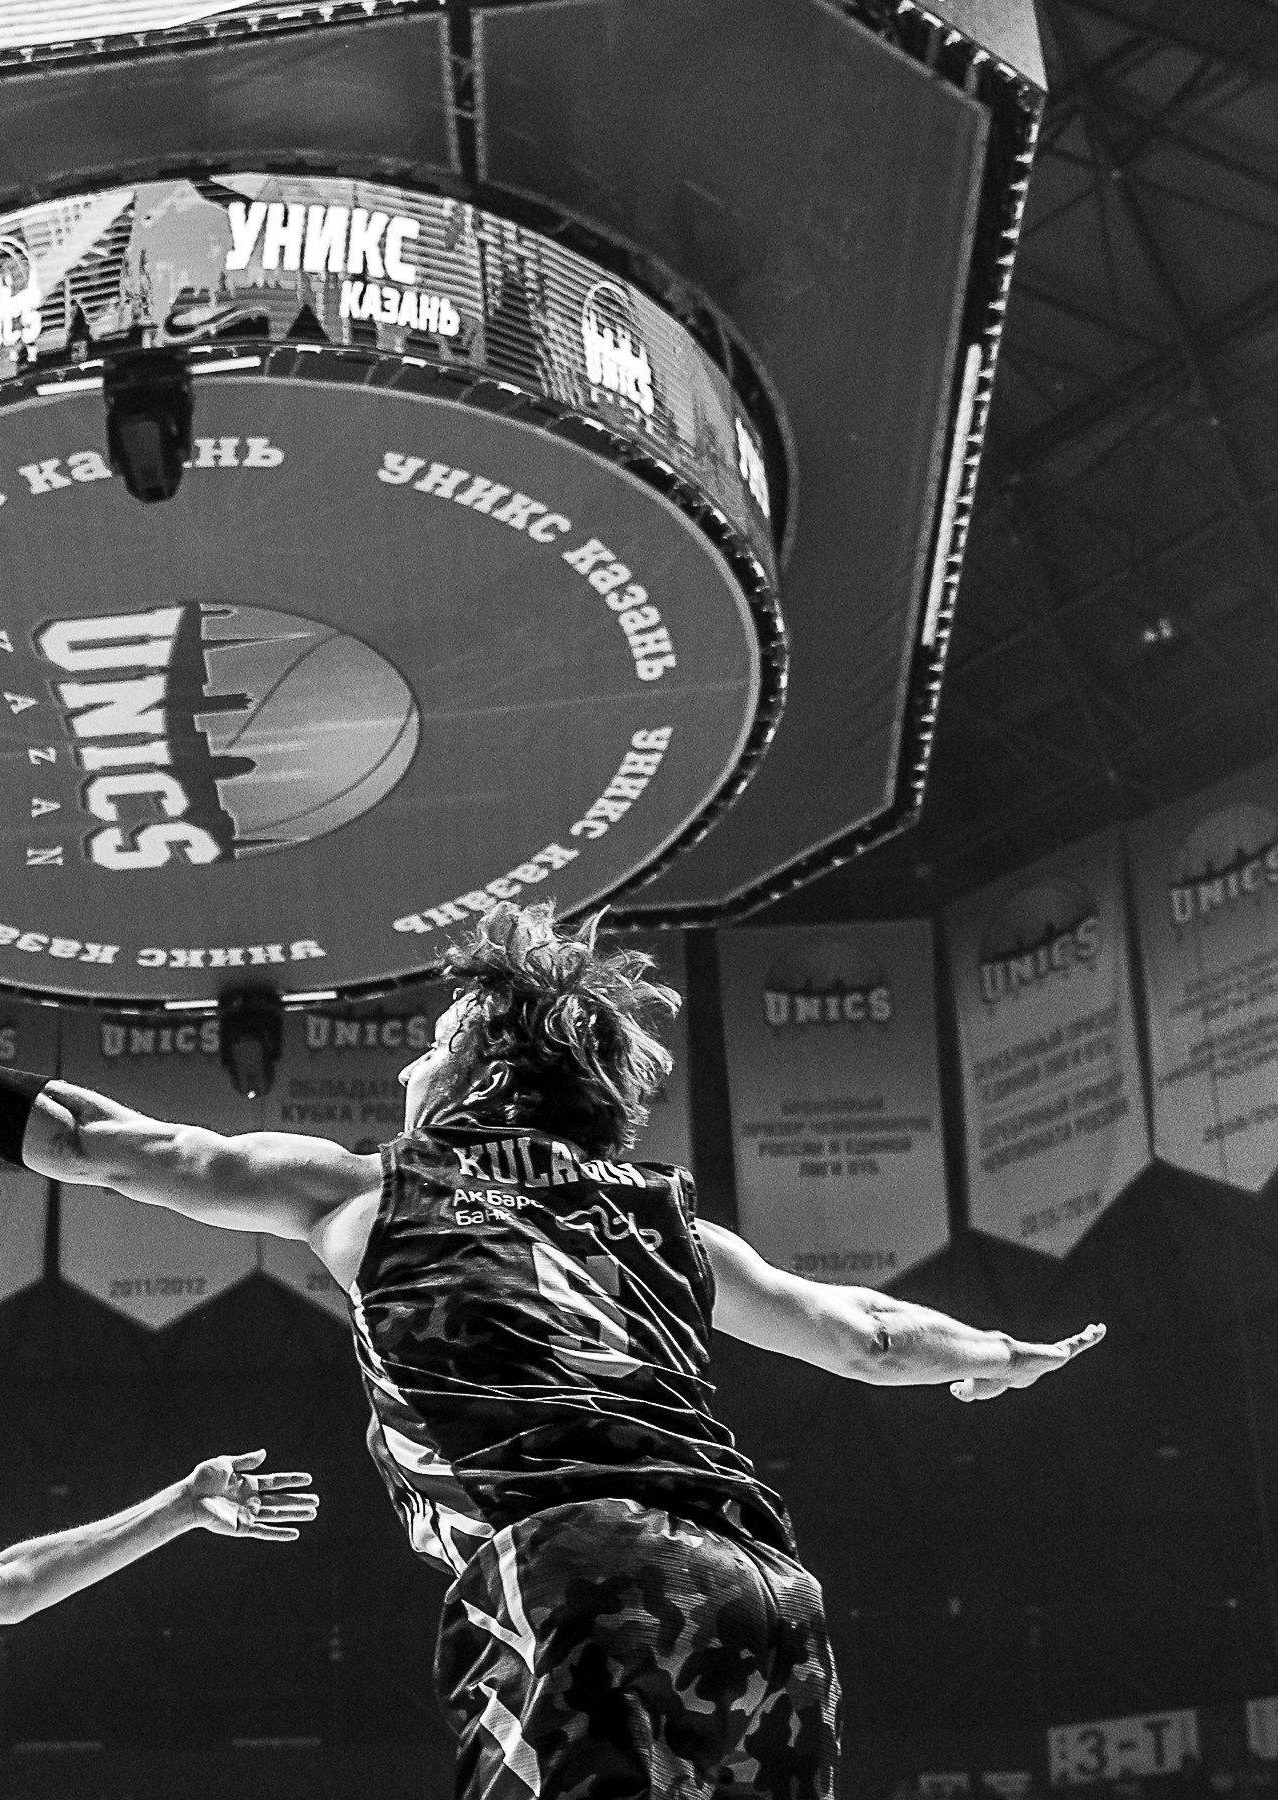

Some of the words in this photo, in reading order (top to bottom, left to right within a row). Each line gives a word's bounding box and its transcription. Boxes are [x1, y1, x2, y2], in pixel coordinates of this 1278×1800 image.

[227, 203, 421, 285] УНИКС
[340, 280, 460, 337] КАЗАНЬ
[36, 606, 221, 871] UNICS
[981, 915, 1100, 1002] UNICS
[306, 1015, 428, 1050] UNICS
[764, 987, 891, 1026] UNICS
[101, 1021, 220, 1056] UNICS
